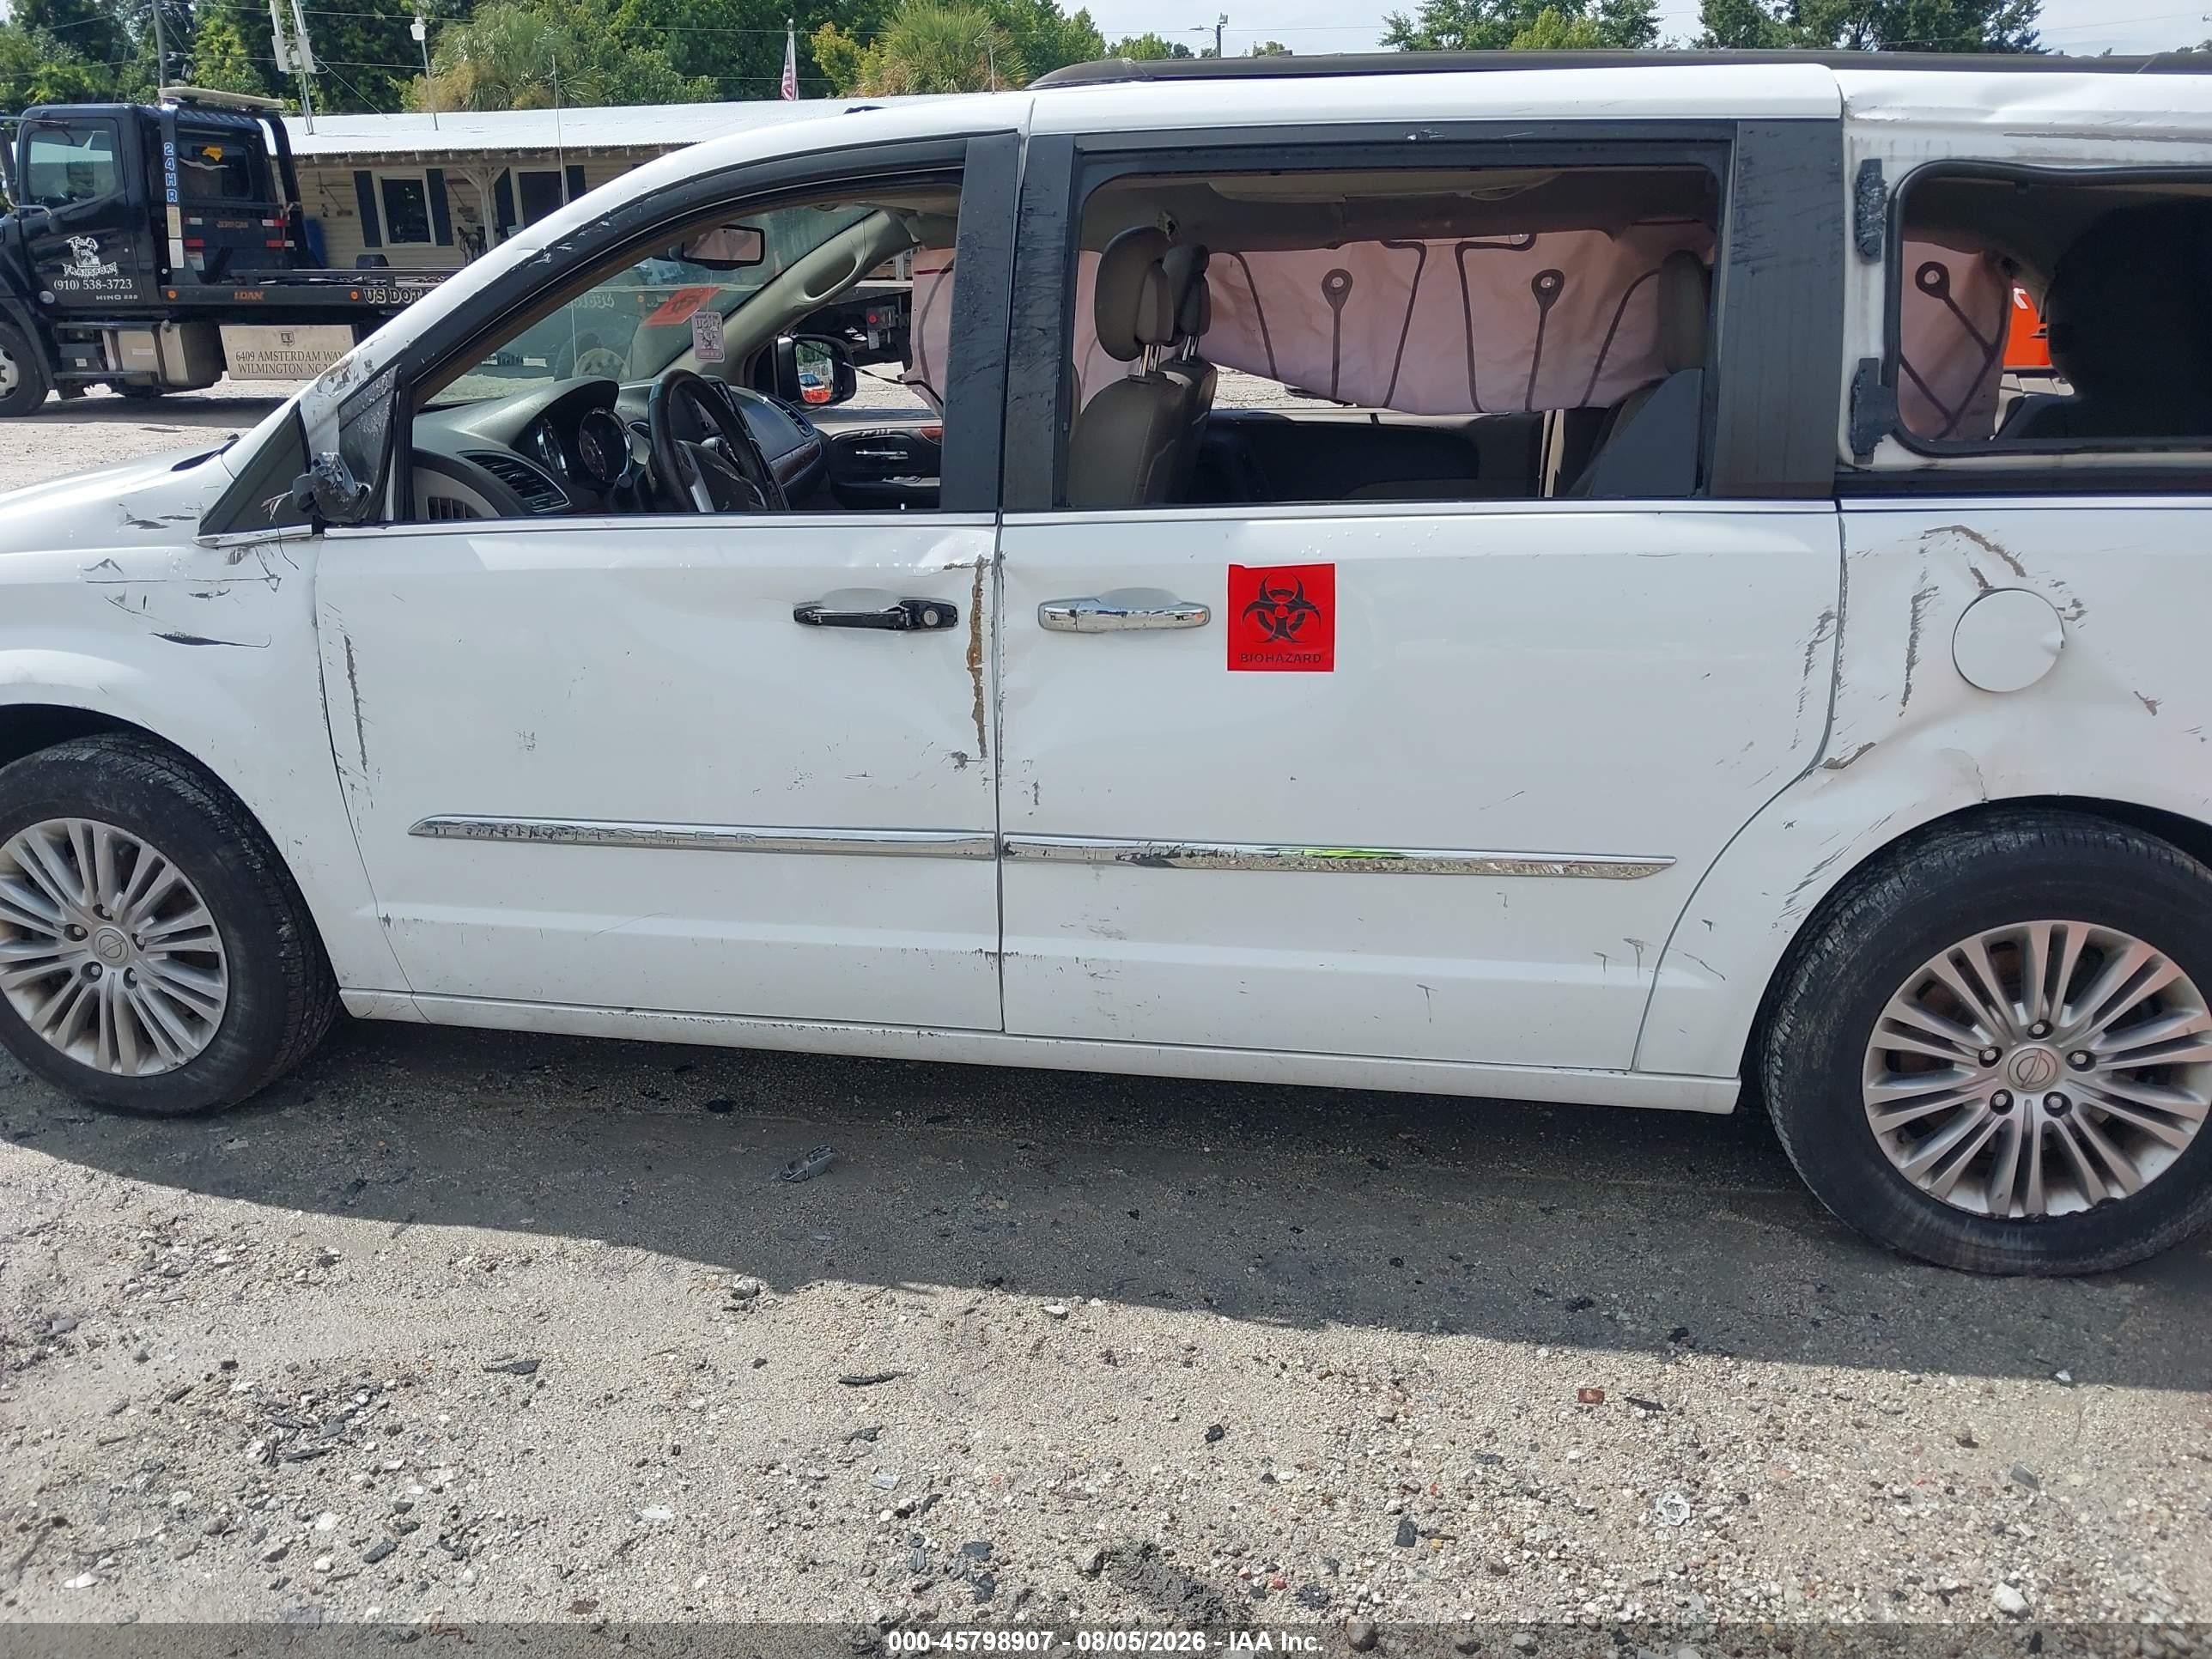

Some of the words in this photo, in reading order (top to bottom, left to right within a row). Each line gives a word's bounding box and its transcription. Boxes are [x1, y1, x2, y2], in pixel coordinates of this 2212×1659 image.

[61, 261, 118, 277] TRANSPORT
[53, 279, 79, 290] (910)
[82, 278, 132, 290] 538-3723
[363, 288, 386, 304] US
[389, 288, 423, 304] DOT
[235, 351, 255, 362] 6409
[258, 350, 321, 362] AMSTERDAM
[322, 350, 344, 362] WAY
[238, 363, 303, 374] WILMINGTON
[308, 363, 323, 374] NC
[1240, 653, 1322, 664] BIOHAZARD
